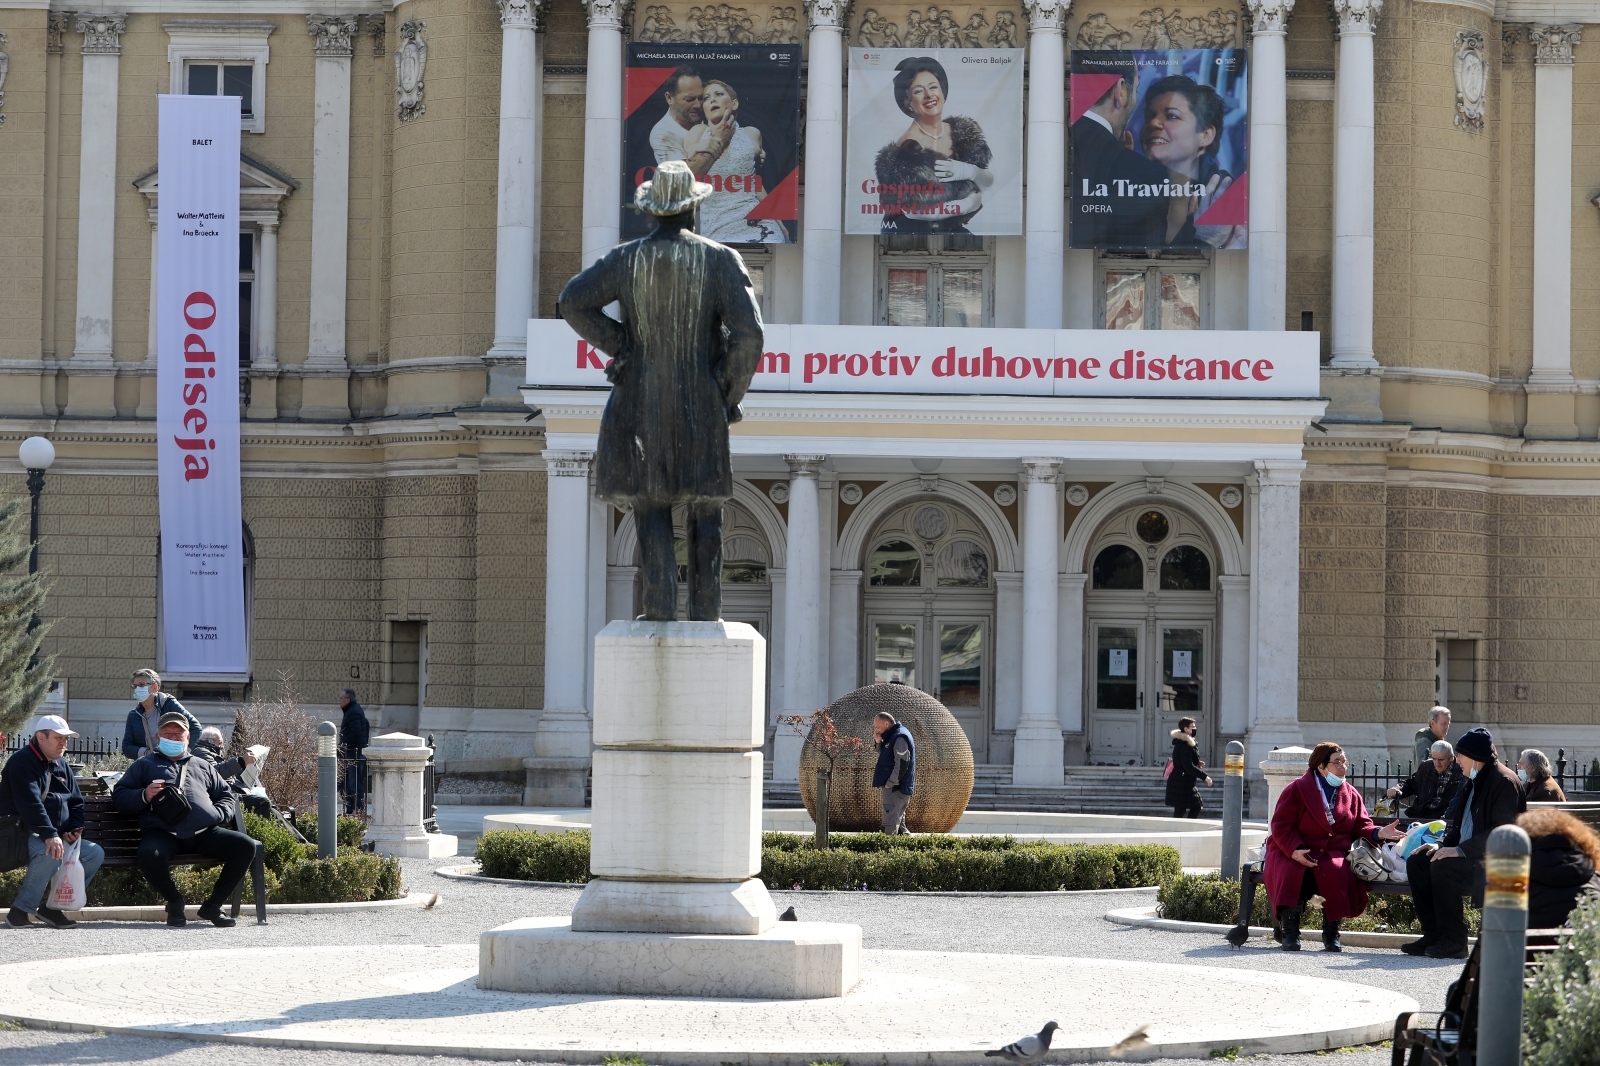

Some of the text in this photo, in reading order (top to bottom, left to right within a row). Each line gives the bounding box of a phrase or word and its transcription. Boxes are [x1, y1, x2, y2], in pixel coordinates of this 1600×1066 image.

[961, 56, 1012, 66] Olivera Baljak
[634, 165, 763, 193] Cmen
[1082, 178, 1207, 197] La Traviata
[860, 200, 961, 215] ministarka
[1081, 204, 1113, 213] OPERA
[177, 212, 198, 220] Walter
[194, 229, 219, 237] Broeckx
[803, 346, 921, 383] protiv
[931, 346, 1101, 380] duhovne
[1109, 349, 1275, 381] distance
[173, 291, 217, 483] Odiseja
